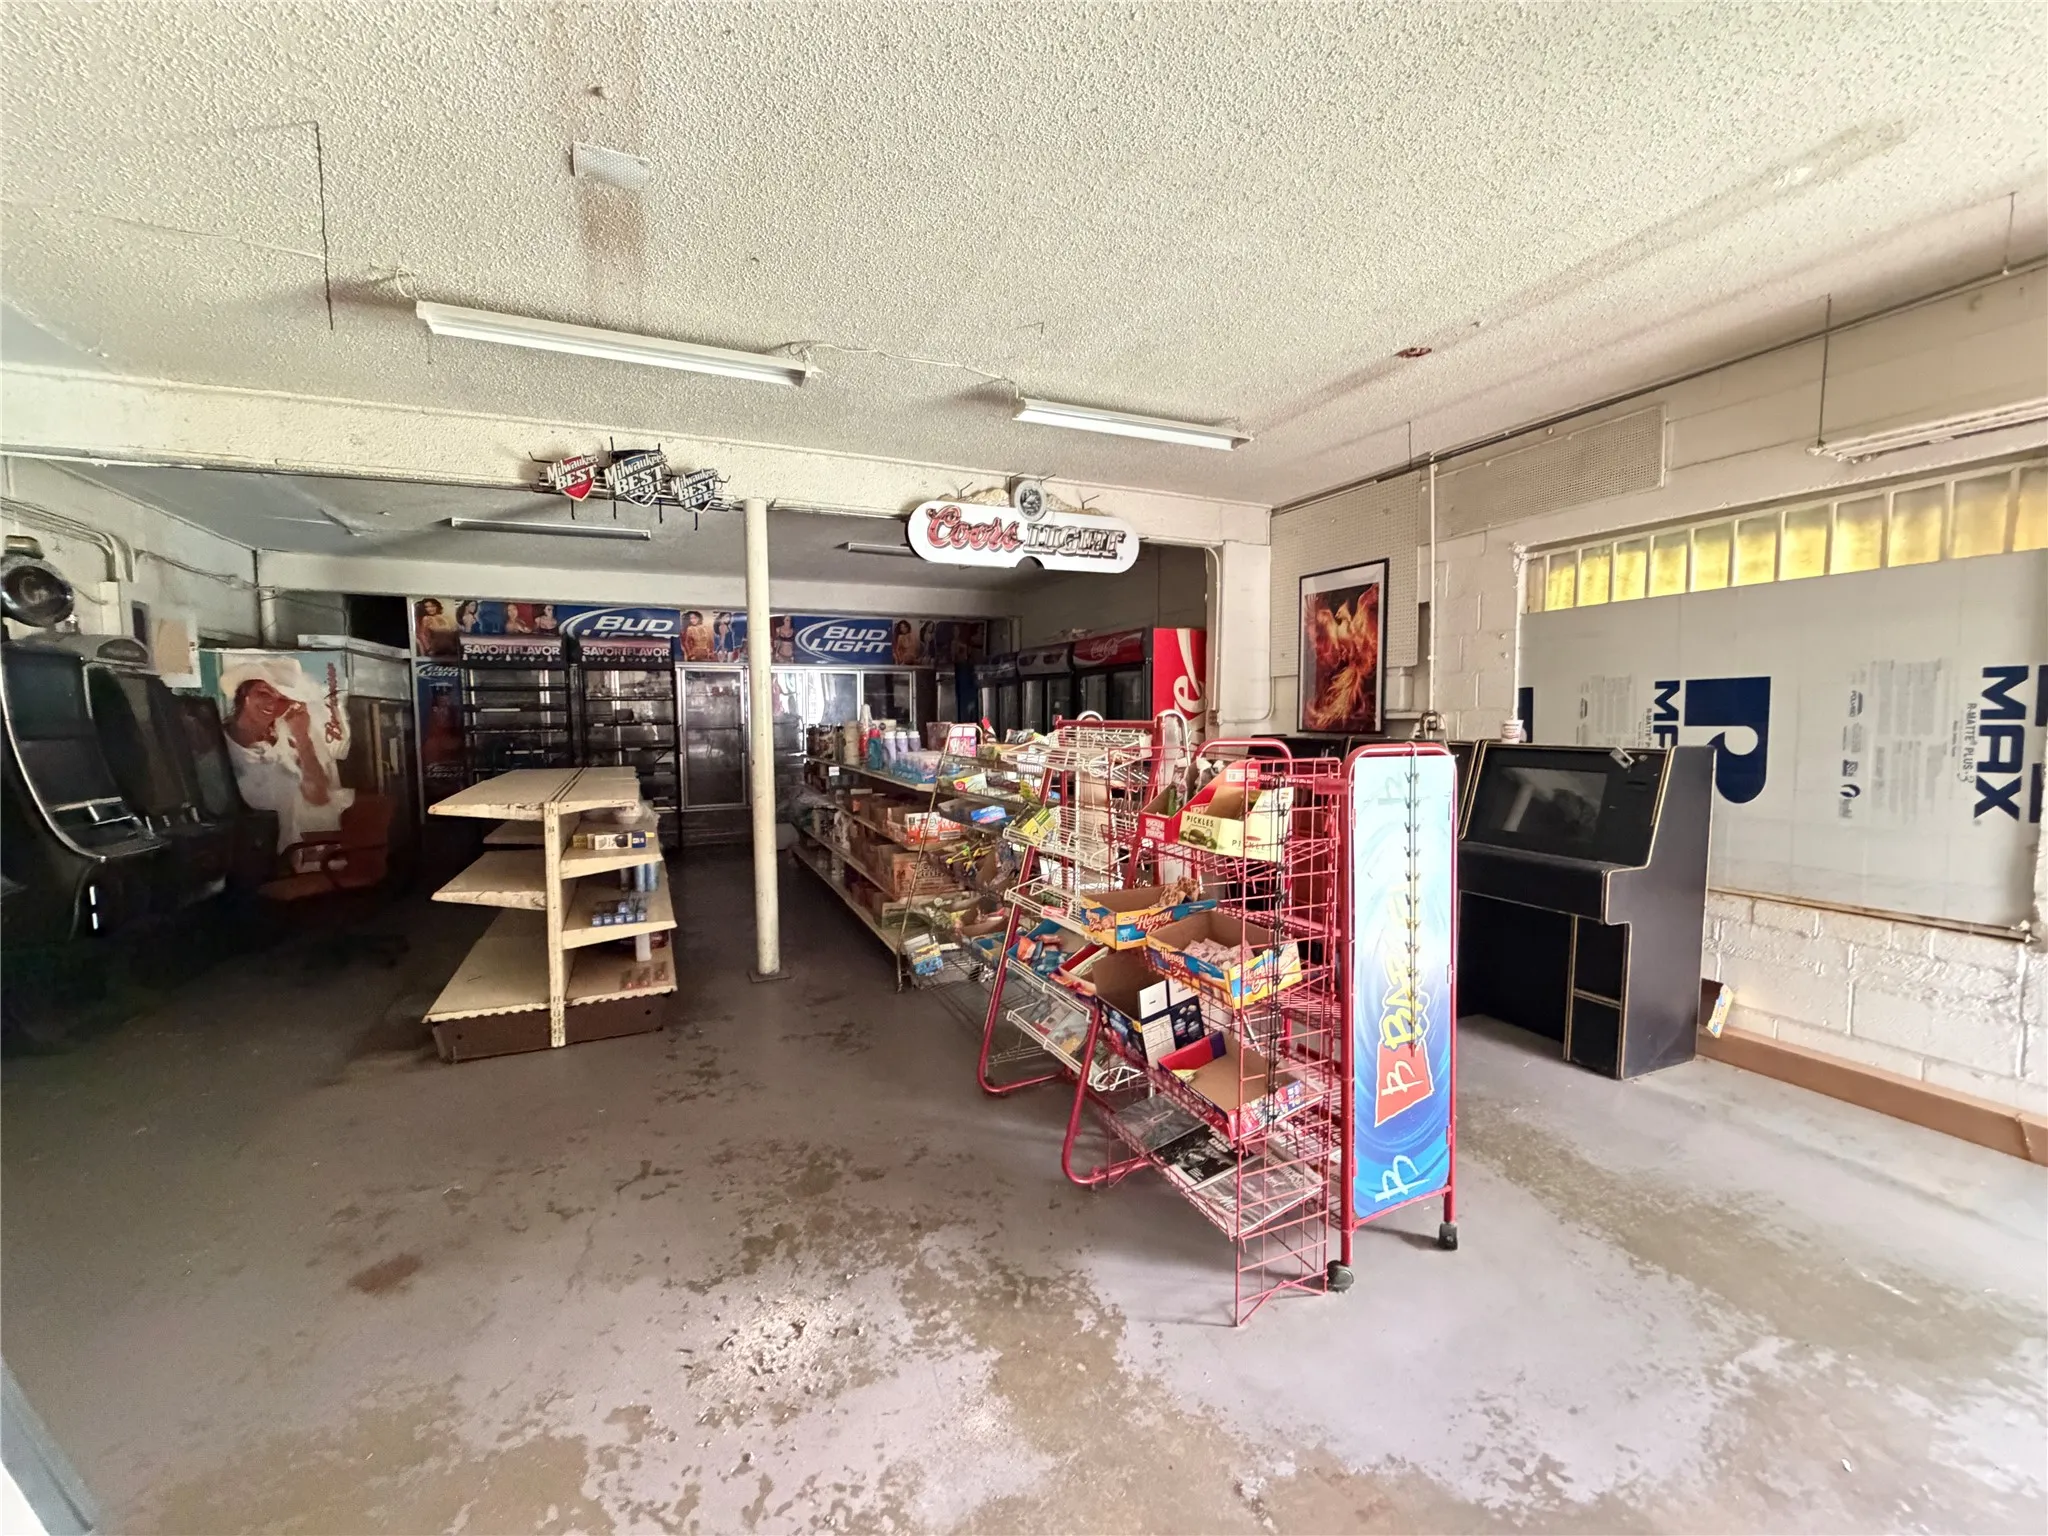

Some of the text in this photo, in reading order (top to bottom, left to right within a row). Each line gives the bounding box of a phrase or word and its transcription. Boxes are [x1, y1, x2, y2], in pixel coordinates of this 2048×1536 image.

[556, 464, 597, 491] BEST
[616, 464, 663, 496] BEST
[680, 477, 716, 501] BEST
[684, 491, 714, 509] ICE
[926, 505, 1127, 559] Coors LIGHT
[594, 616, 674, 632] BUD
[823, 626, 888, 640] BUD
[810, 639, 892, 653] LIGHT
[1973, 665, 2029, 821] MAX
[1186, 815, 1214, 827] PICKLES
[1135, 911, 1173, 930] Honey
[1160, 946, 1185, 967] Honey
